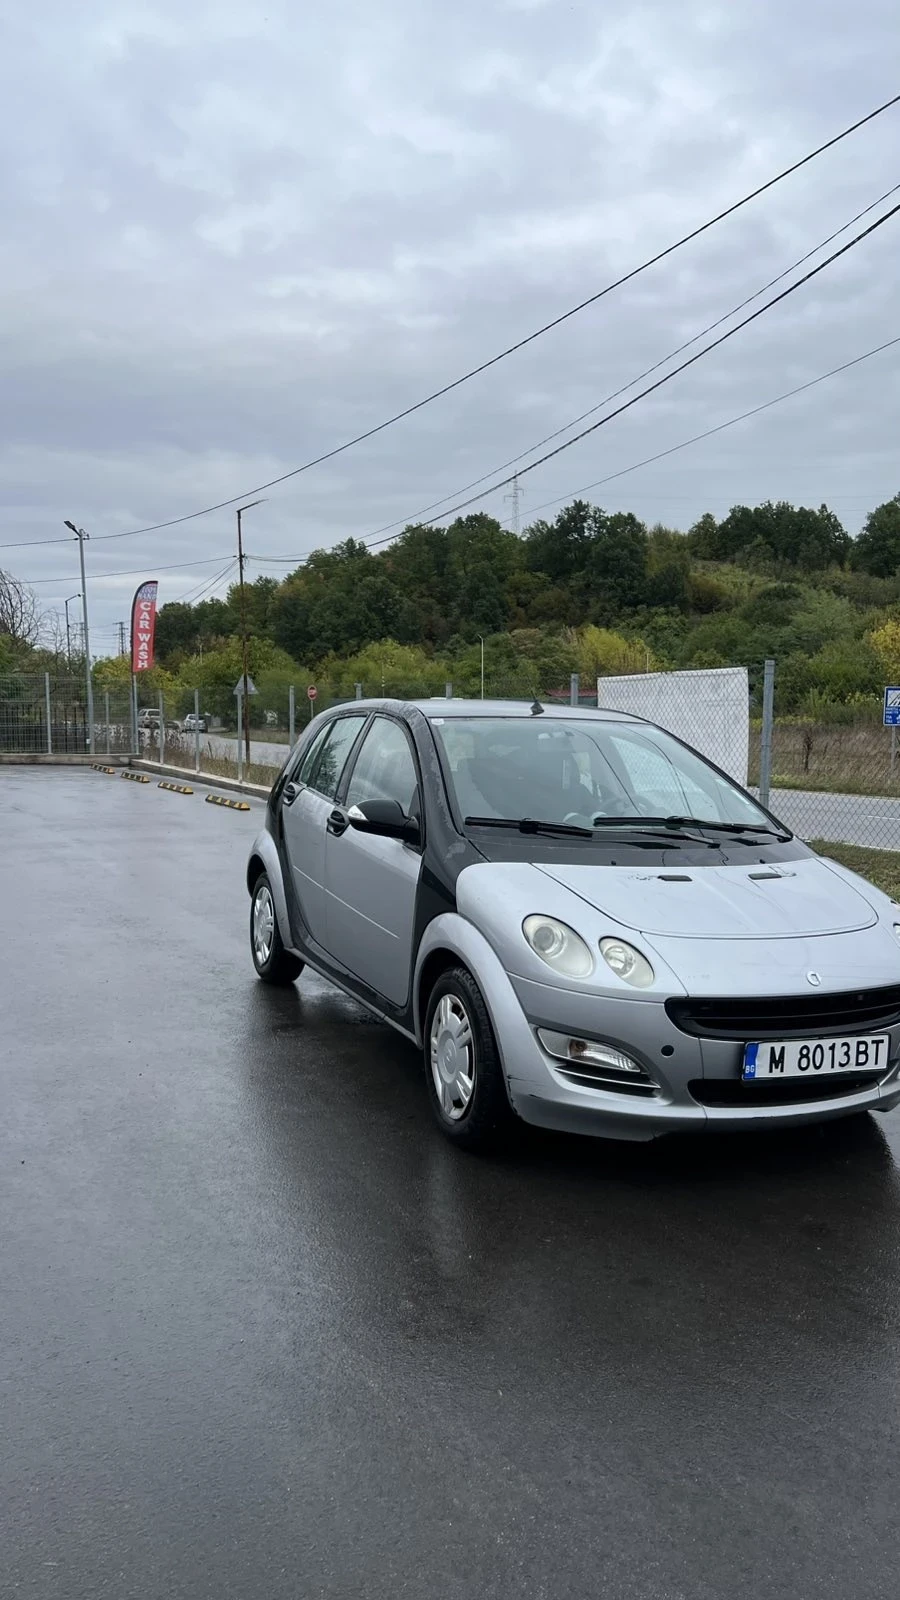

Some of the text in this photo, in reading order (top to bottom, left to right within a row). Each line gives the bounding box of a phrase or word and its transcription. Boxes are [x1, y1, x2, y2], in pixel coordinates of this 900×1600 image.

[139, 602, 151, 629] CAR
[137, 633, 151, 668] WASH
[745, 1064, 755, 1074] BG
[768, 1046, 785, 1073] M
